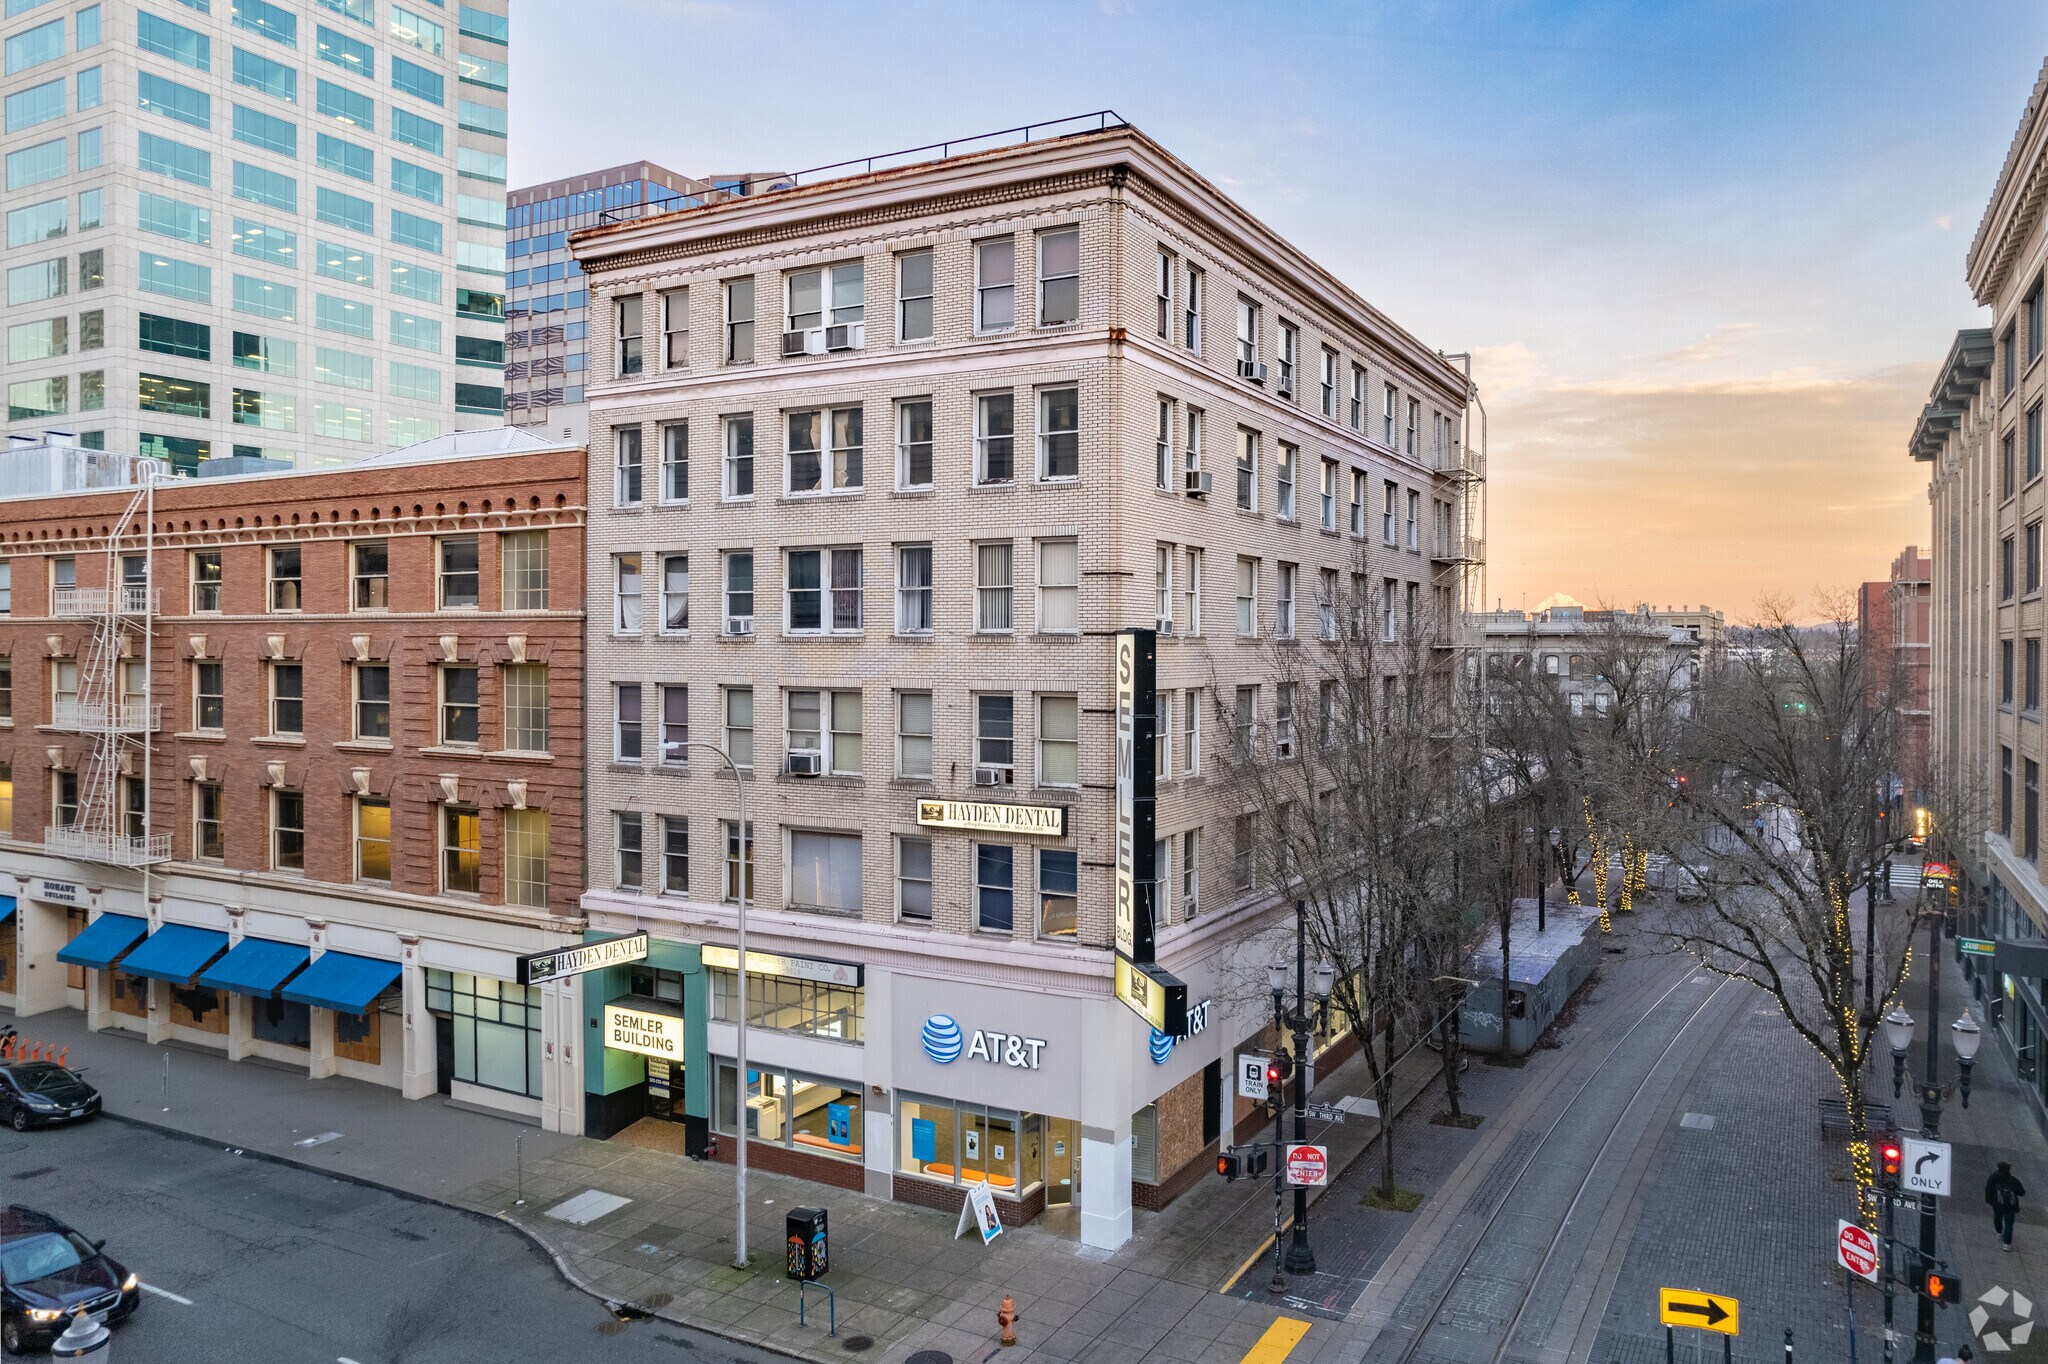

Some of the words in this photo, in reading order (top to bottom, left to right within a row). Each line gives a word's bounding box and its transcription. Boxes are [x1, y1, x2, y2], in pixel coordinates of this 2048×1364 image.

[1119, 643, 1132, 923] SEMLER
[948, 803, 1002, 823] HAYDEN
[1005, 807, 1060, 828] DENTAL
[43, 881, 76, 893] MOHAWK
[44, 891, 76, 901] BUILDING
[1117, 926, 1133, 947] BLDG.
[557, 946, 602, 972] HAYDEN
[605, 937, 646, 960] DENTAL
[1962, 942, 1996, 952] SUBWAY
[758, 955, 786, 965] LADDER
[790, 959, 814, 970] PAINT
[818, 963, 831, 972] CO.
[614, 1013, 663, 1034] SEMLER
[614, 1029, 674, 1052] BUILDING
[967, 1030, 1047, 1070] AT&T
[1245, 1080, 1264, 1088] TRAIN
[1245, 1085, 1262, 1094] ONLY
[1308, 1110, 1317, 1118] SW
[1319, 1112, 1333, 1120] THIRD
[1334, 1114, 1344, 1122] AVE
[1292, 1152, 1303, 1160] DO
[1911, 1176, 1942, 1190] ONLY
[1867, 1193, 1877, 1202] SW
[1882, 1196, 1902, 1207] TRD
[1904, 1201, 1917, 1210] AVE
[1843, 1230, 1854, 1241] DO
[1858, 1238, 1872, 1250] NOT
